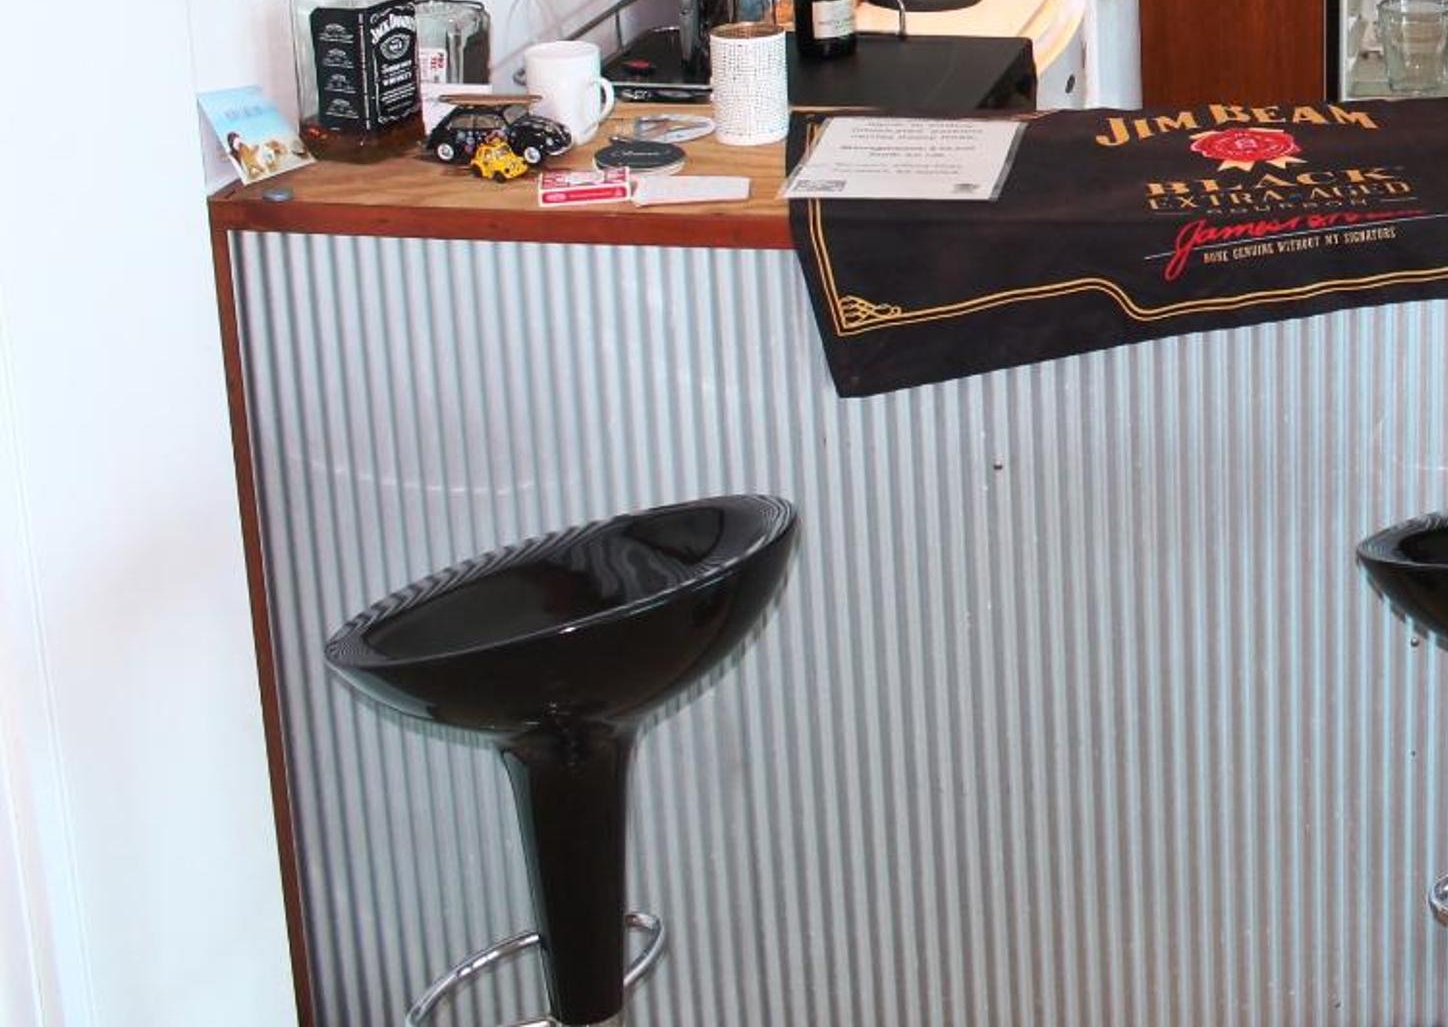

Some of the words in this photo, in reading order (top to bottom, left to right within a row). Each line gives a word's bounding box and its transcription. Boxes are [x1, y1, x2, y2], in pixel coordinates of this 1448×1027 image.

[1096, 111, 1198, 146] JIM
[1209, 104, 1379, 129] BEAM
[1147, 168, 1399, 196] BLACK
